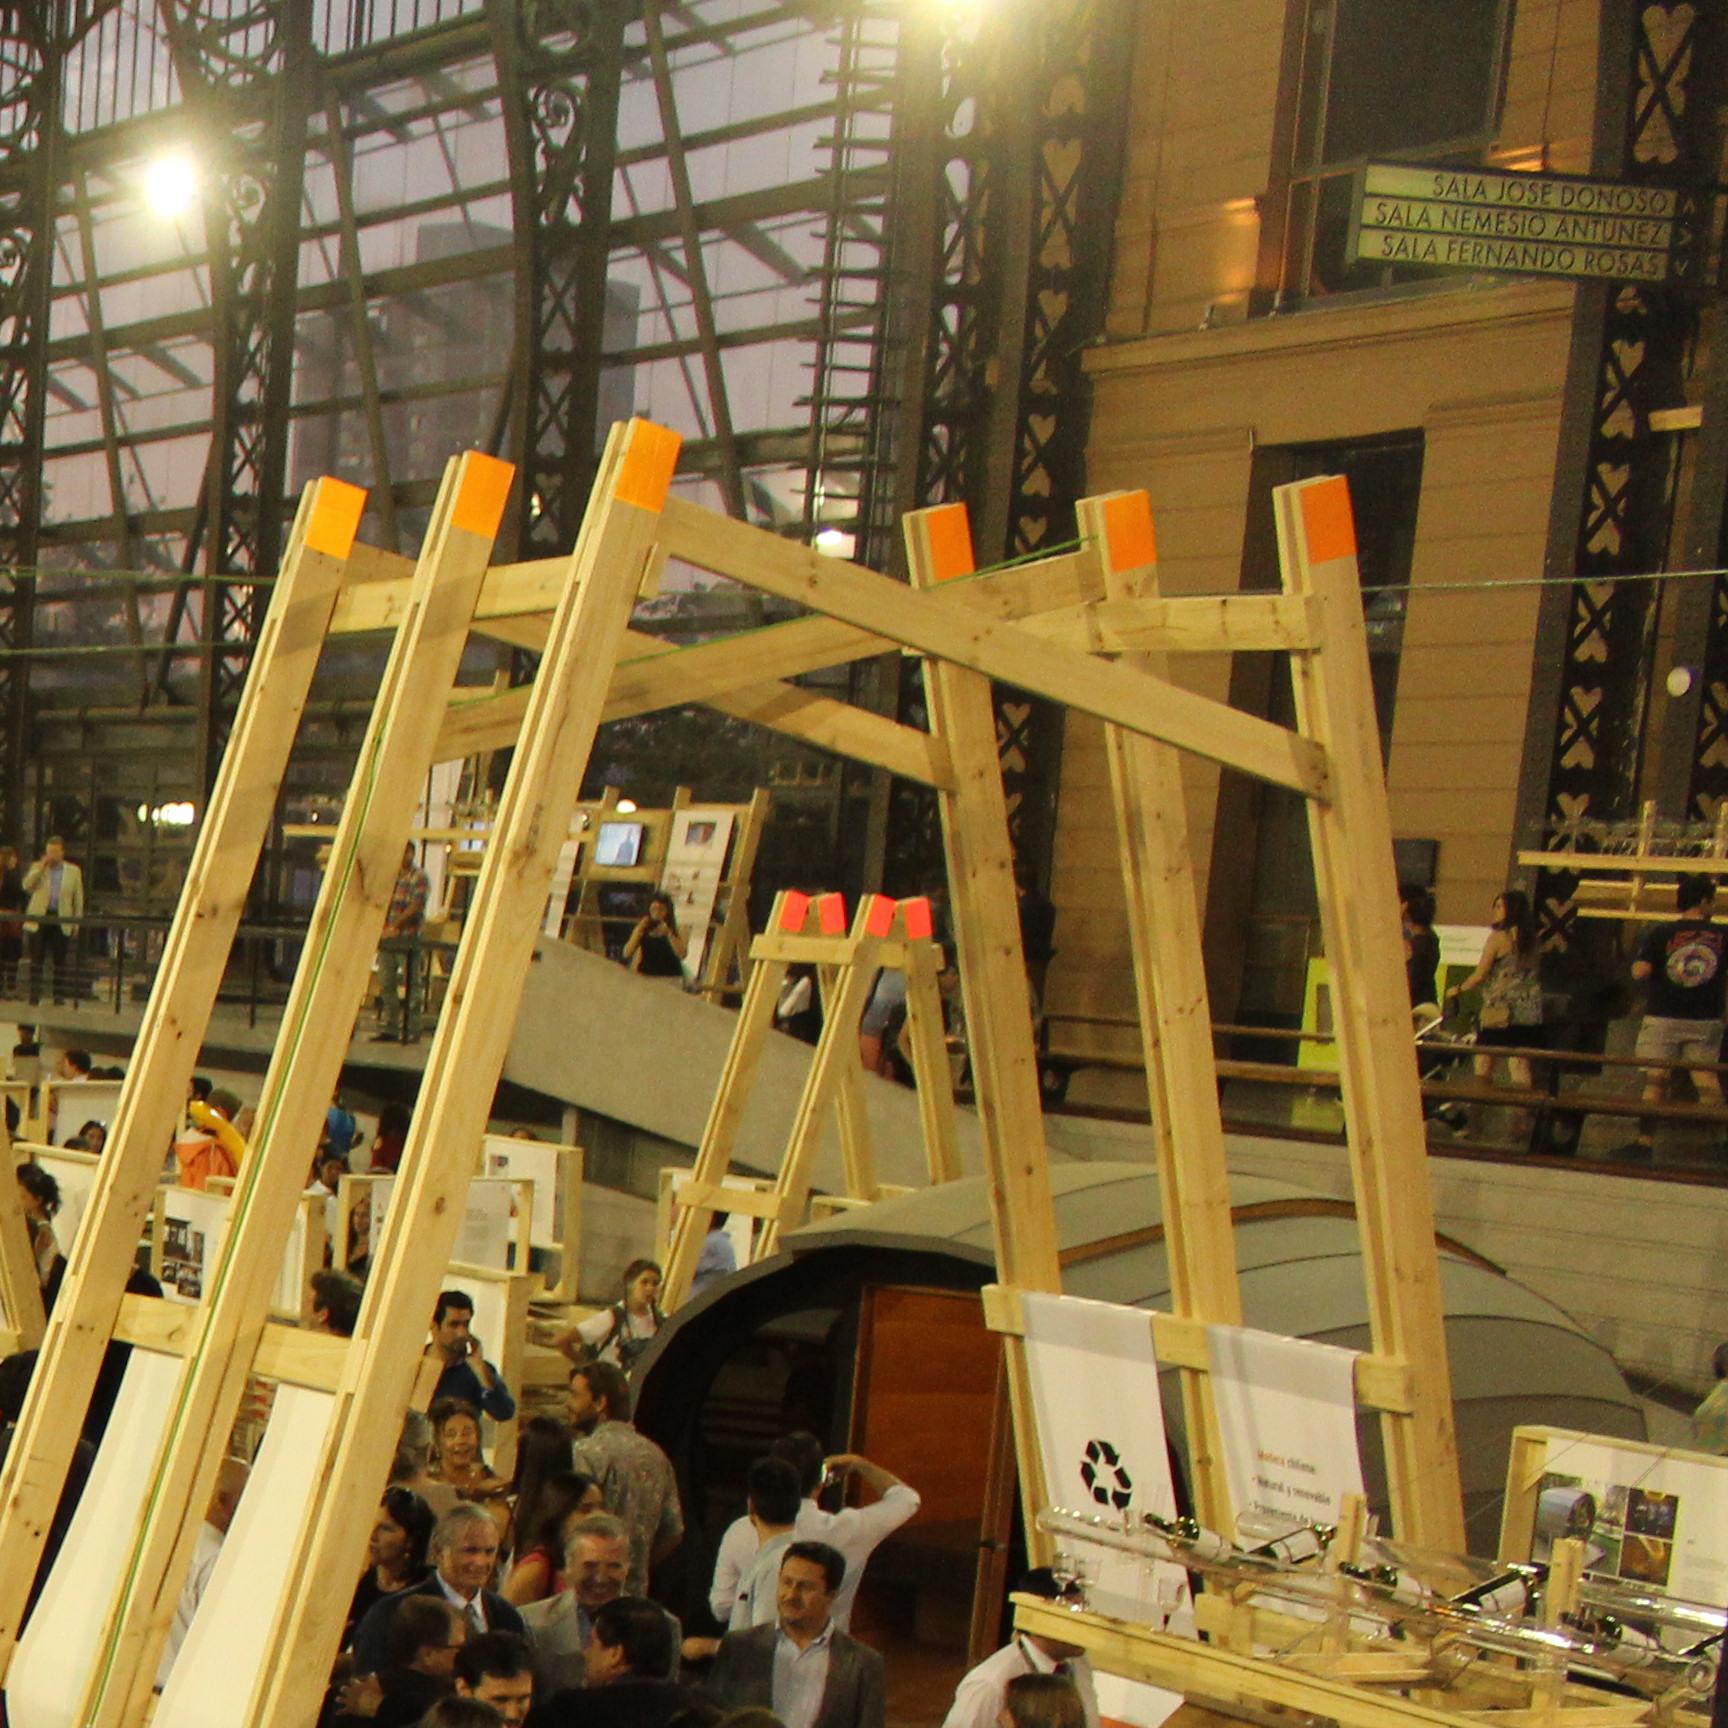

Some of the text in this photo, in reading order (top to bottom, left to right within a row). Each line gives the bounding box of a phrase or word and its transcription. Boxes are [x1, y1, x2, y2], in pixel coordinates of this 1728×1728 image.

[1433, 176, 1669, 214] SALA JOSE DONOSO
[1374, 202, 1667, 246] SALA NEMESIO ANTUNEZ
[1381, 235, 1660, 277] SALA FERNANDO ROSAS
